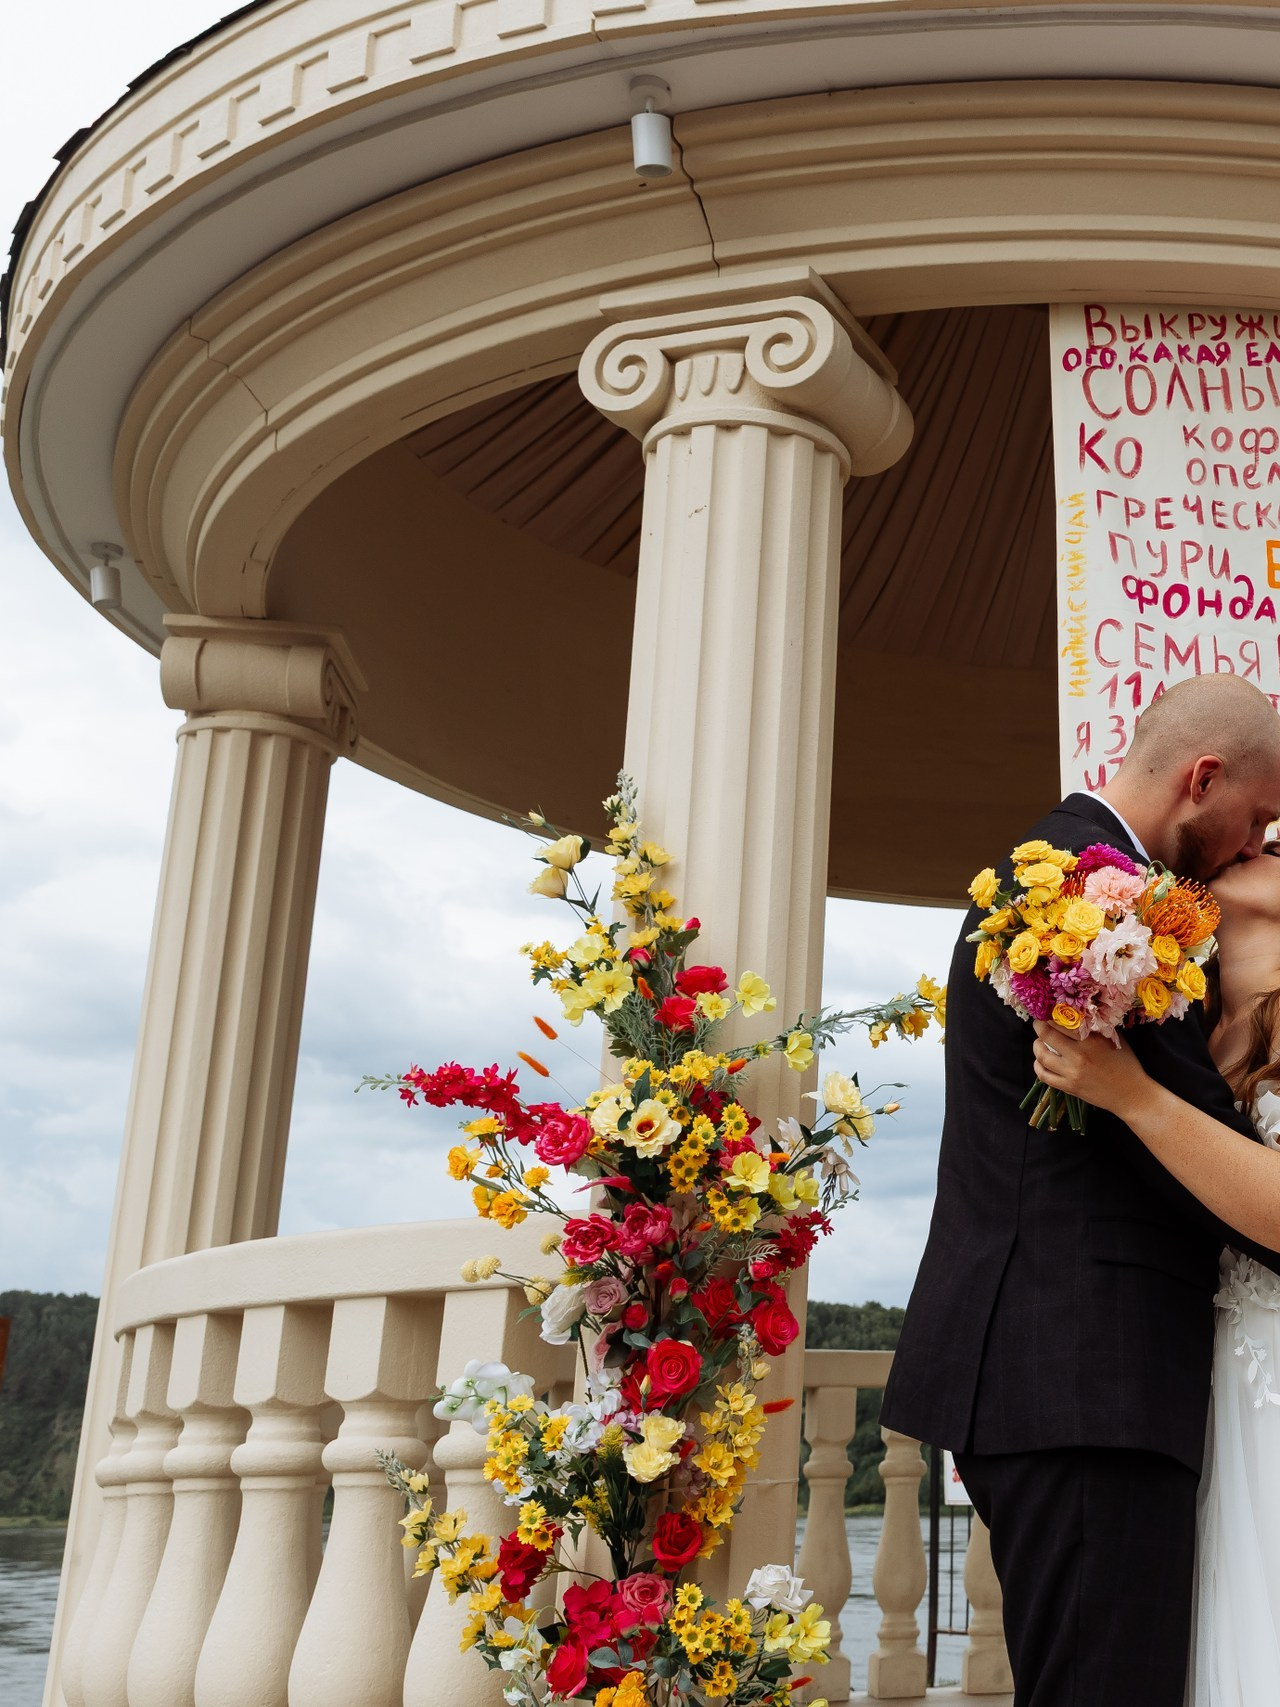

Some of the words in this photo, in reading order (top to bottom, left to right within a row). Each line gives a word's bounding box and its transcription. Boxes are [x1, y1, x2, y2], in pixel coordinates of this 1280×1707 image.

[1129, 341, 1232, 367] КАКАЯ
[1108, 531, 1232, 582] ПУРИ
[1094, 618, 1262, 683] СЕМЬЯ
